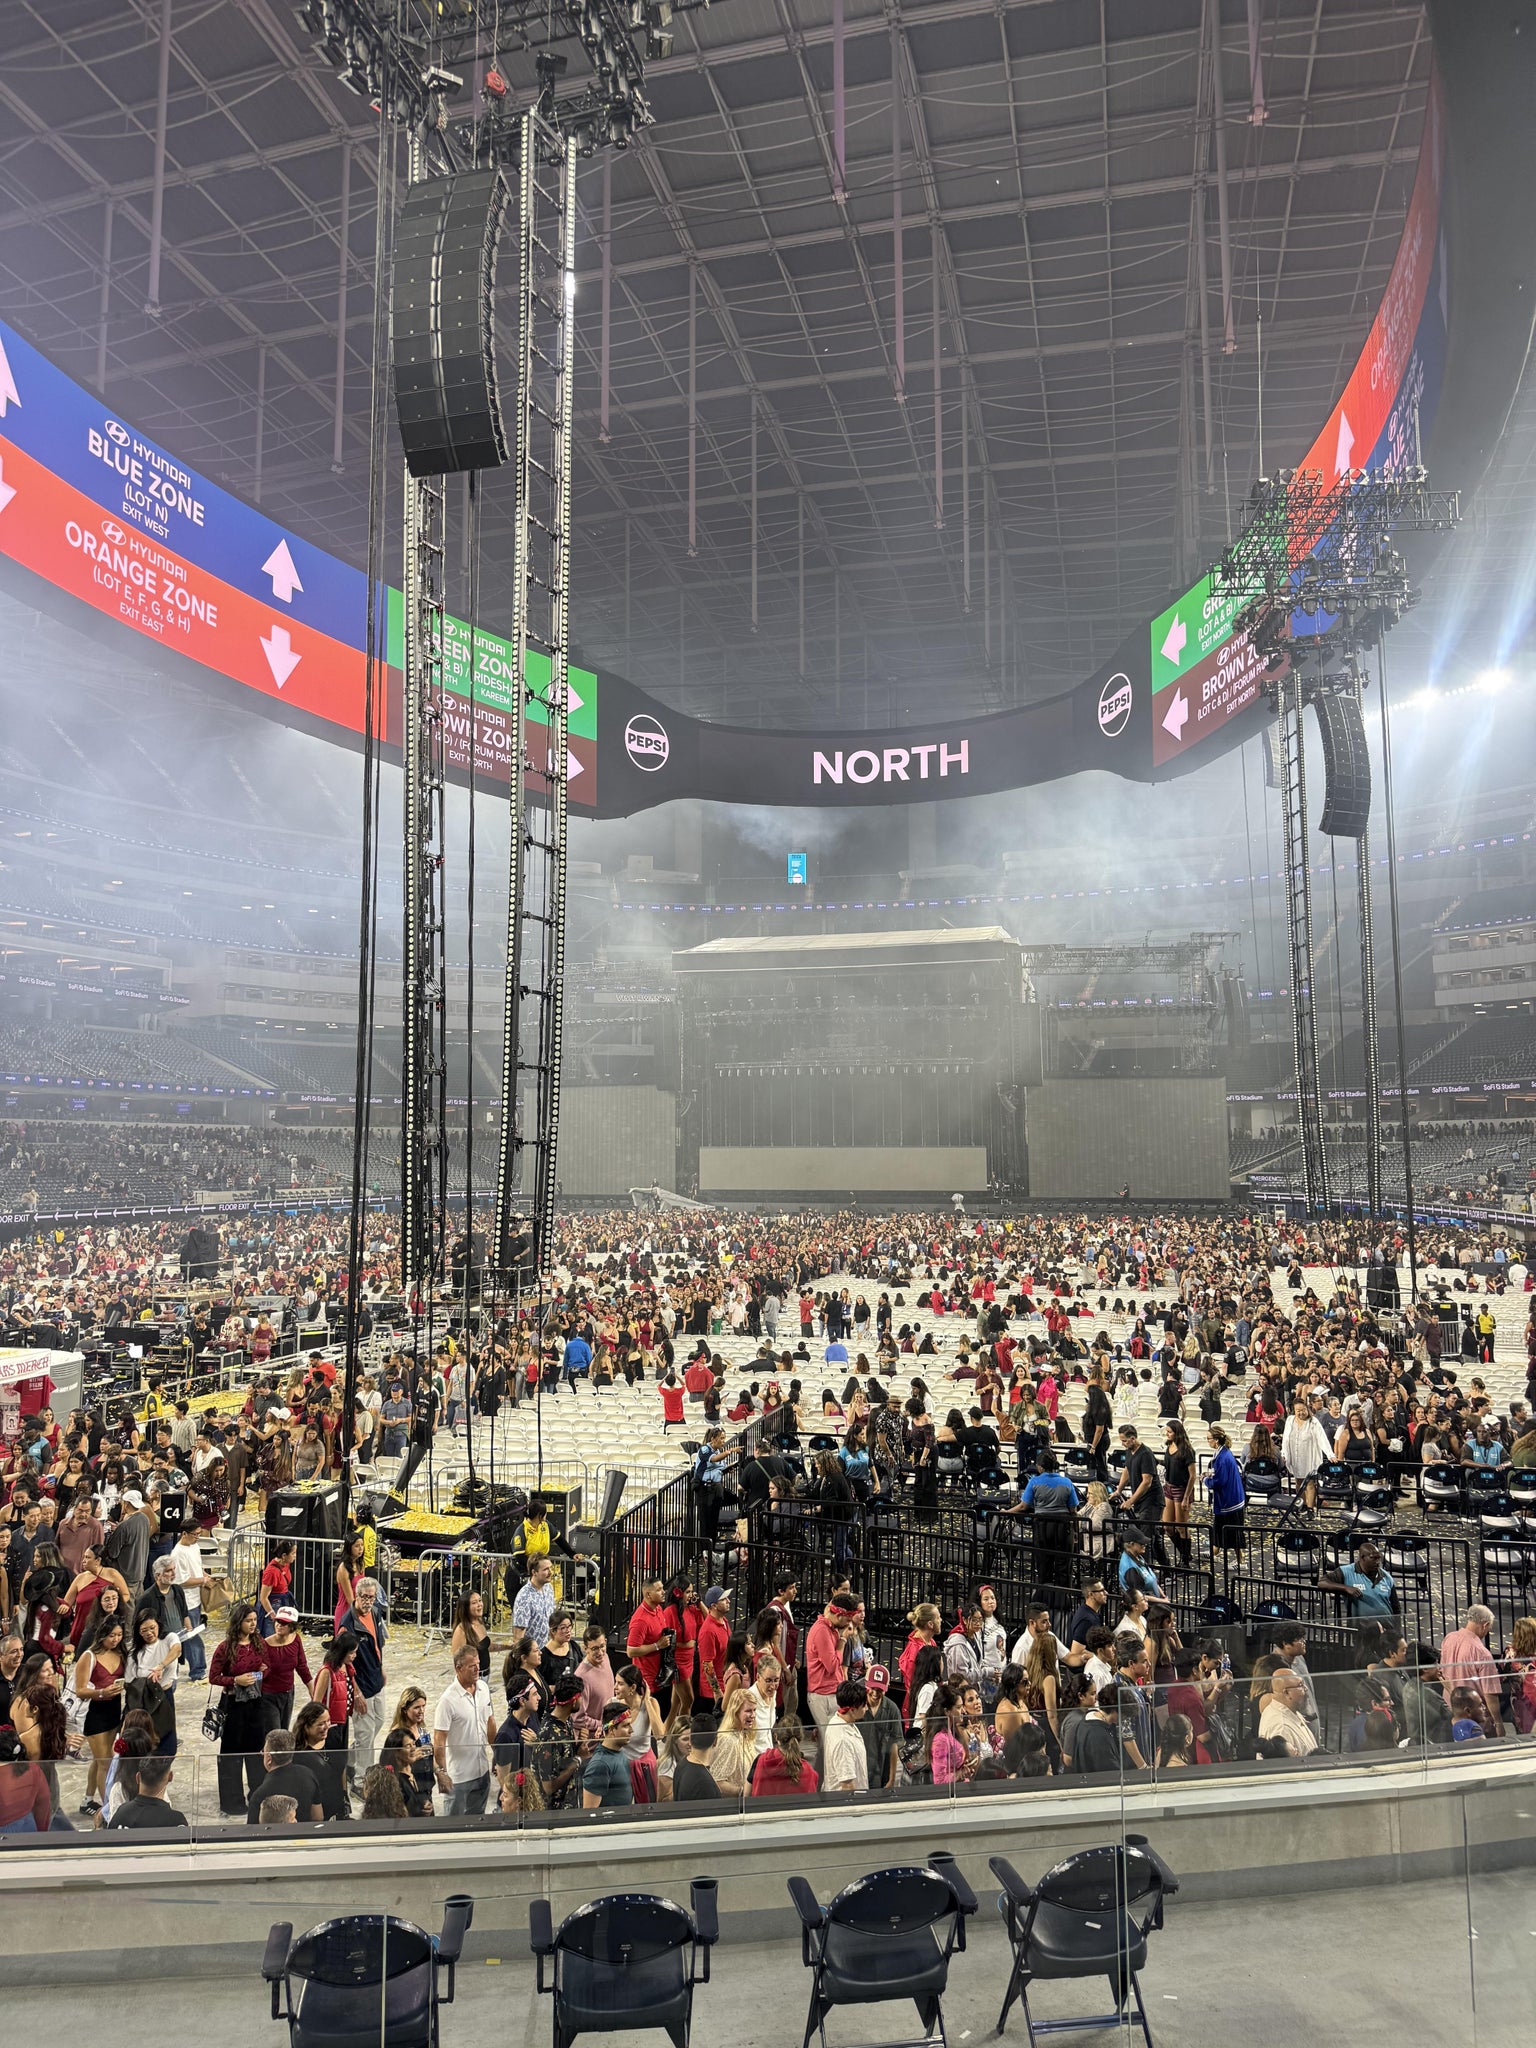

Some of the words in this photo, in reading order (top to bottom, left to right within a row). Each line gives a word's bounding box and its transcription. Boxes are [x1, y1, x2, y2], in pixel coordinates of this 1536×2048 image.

[88, 428, 143, 487] BLUE
[149, 471, 205, 527] ZONE
[133, 439, 191, 490] HYUNDAI
[125, 482, 152, 511] (LOT
[155, 502, 168, 524] N)
[122, 502, 143, 522] EXIT
[144, 515, 169, 539] WEST
[65, 521, 157, 594] ORANGE
[162, 578, 217, 628] ZONE
[130, 537, 187, 583] HYUNDAI
[93, 564, 121, 593] (LOT
[124, 585, 135, 604] E,
[138, 592, 148, 611] F,
[151, 601, 163, 620] G,
[166, 609, 175, 625] &
[178, 614, 191, 633] H)
[119, 602, 140, 621] EXIT
[141, 613, 164, 634] EAST
[1198, 619, 1213, 642] (LOT
[1213, 615, 1220, 628] A
[424, 630, 471, 662] REEN
[479, 652, 513, 682] ZON
[1201, 635, 1213, 652] EXIT
[432, 667, 458, 685] NRTH
[480, 688, 510, 705] KAREEM
[1203, 652, 1245, 702] BROWN
[1232, 667, 1255, 695] (FORUM
[1100, 691, 1131, 718] PEPSI
[1227, 698, 1238, 714] EXIT
[1237, 684, 1255, 706] NORTH
[449, 749, 466, 762] EXIT
[628, 733, 666, 753] PEPSI
[812, 740, 969, 784] NORTH
[14, 1214, 30, 1223] EXIT
[0, 1364, 15, 1377] ARS
[16, 1356, 49, 1374] MERCH
[164, 1507, 181, 1519] C4
